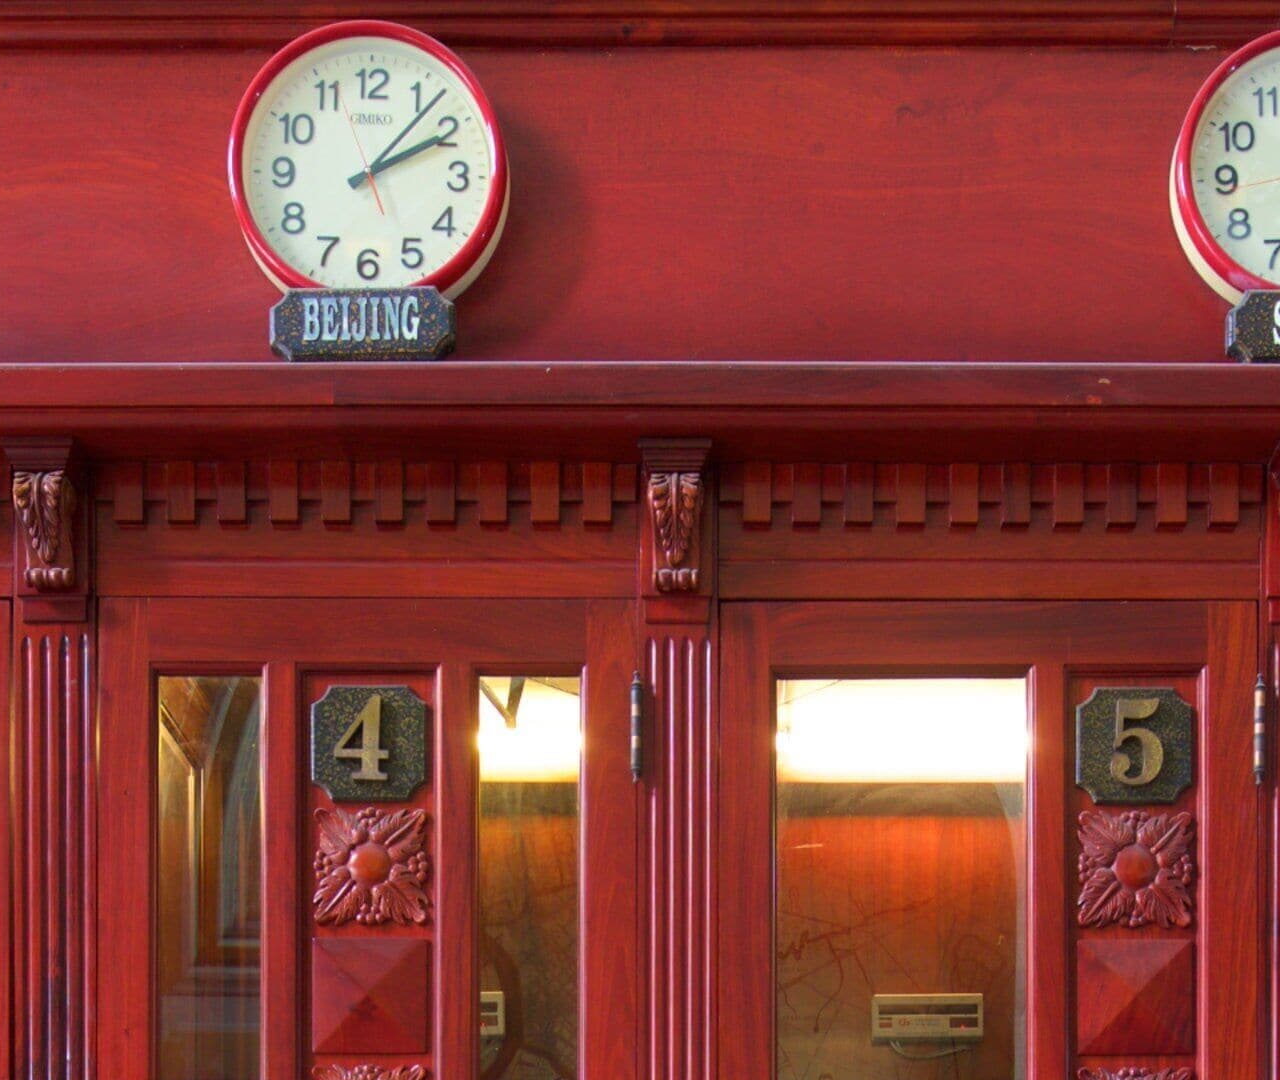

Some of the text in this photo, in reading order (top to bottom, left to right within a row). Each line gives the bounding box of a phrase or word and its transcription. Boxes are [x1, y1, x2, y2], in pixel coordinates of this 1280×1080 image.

[315, 80, 339, 111] 11
[355, 68, 389, 99] 12
[411, 82, 421, 112] 1
[1253, 86, 1278, 117] 11
[279, 113, 313, 144] 10
[350, 113, 393, 125] GIMIKO
[437, 116, 459, 146] 2
[1219, 121, 1255, 151] 10
[272, 157, 295, 187] 9
[447, 161, 469, 191] 3
[1215, 164, 1238, 195] 9
[281, 202, 306, 234] 8
[432, 207, 456, 237] 4
[1227, 208, 1251, 239] 8
[317, 236, 340, 266] 7
[357, 249, 379, 280] 6
[401, 238, 424, 268] 5
[303, 296, 420, 341] BEIJING
[333, 693, 390, 781] 4
[1109, 697, 1165, 786] 5
